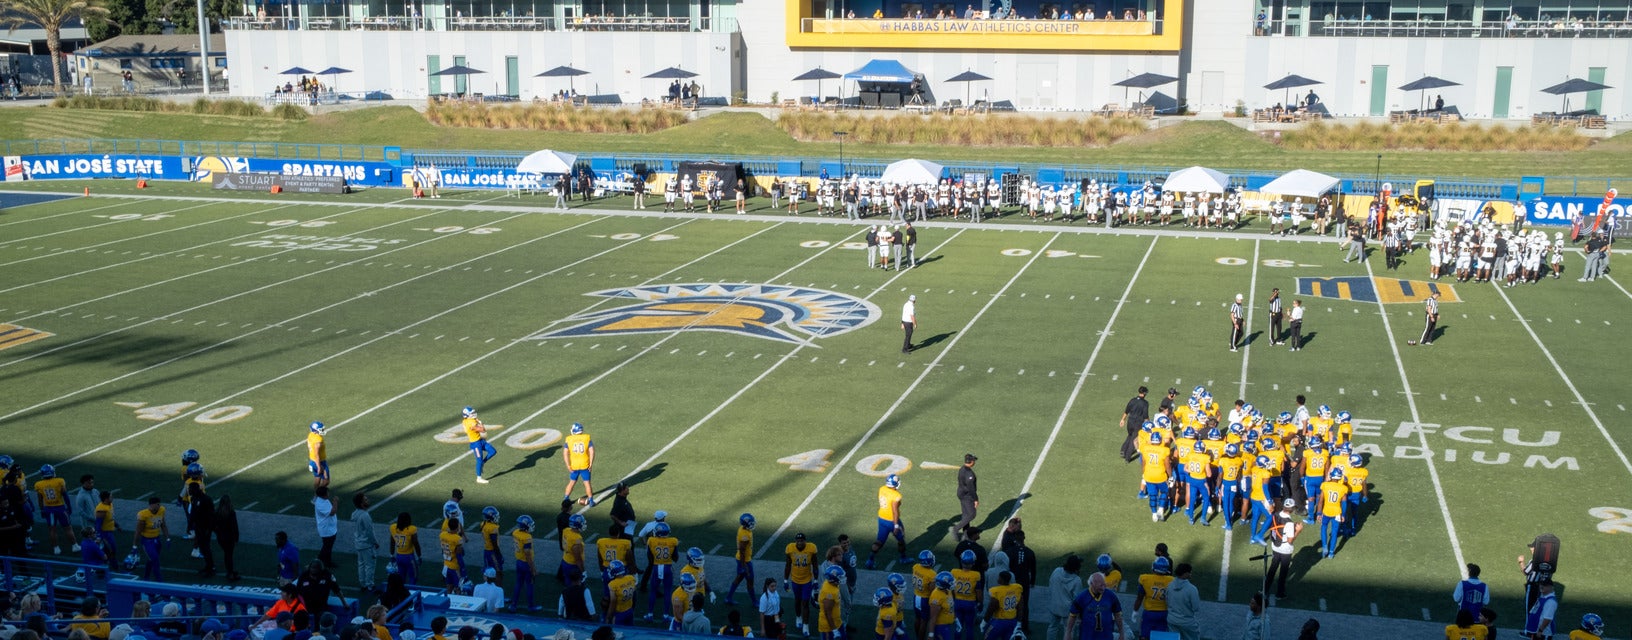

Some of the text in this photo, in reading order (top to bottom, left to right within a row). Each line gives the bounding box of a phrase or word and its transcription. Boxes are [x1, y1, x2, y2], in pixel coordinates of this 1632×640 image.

[894, 22, 1080, 33] HABBAS LAW ATHLETICS CENTER
[22, 160, 59, 175] SAN
[64, 154, 113, 174] JOSÉ
[117, 159, 163, 174] STATE
[282, 163, 366, 181] SPARTANS
[444, 172, 470, 185] SAN
[472, 171, 504, 185] JOSÉ
[238, 175, 276, 186] STUART
[1534, 202, 1584, 220] SAN
[133, 401, 254, 424] 40
[1349, 418, 1561, 447] EFCU
[572, 441, 585, 454] 40
[776, 448, 913, 478] 40
[1149, 453, 1159, 465] 71
[1311, 458, 1324, 468] 86
[1350, 443, 1580, 470] ADIUM
[1189, 461, 1201, 473] 88
[1328, 491, 1339, 503] 10
[655, 546, 670, 560] 28
[956, 581, 972, 595] 22
[1151, 586, 1167, 600] 73
[1094, 612, 1103, 632] 1
